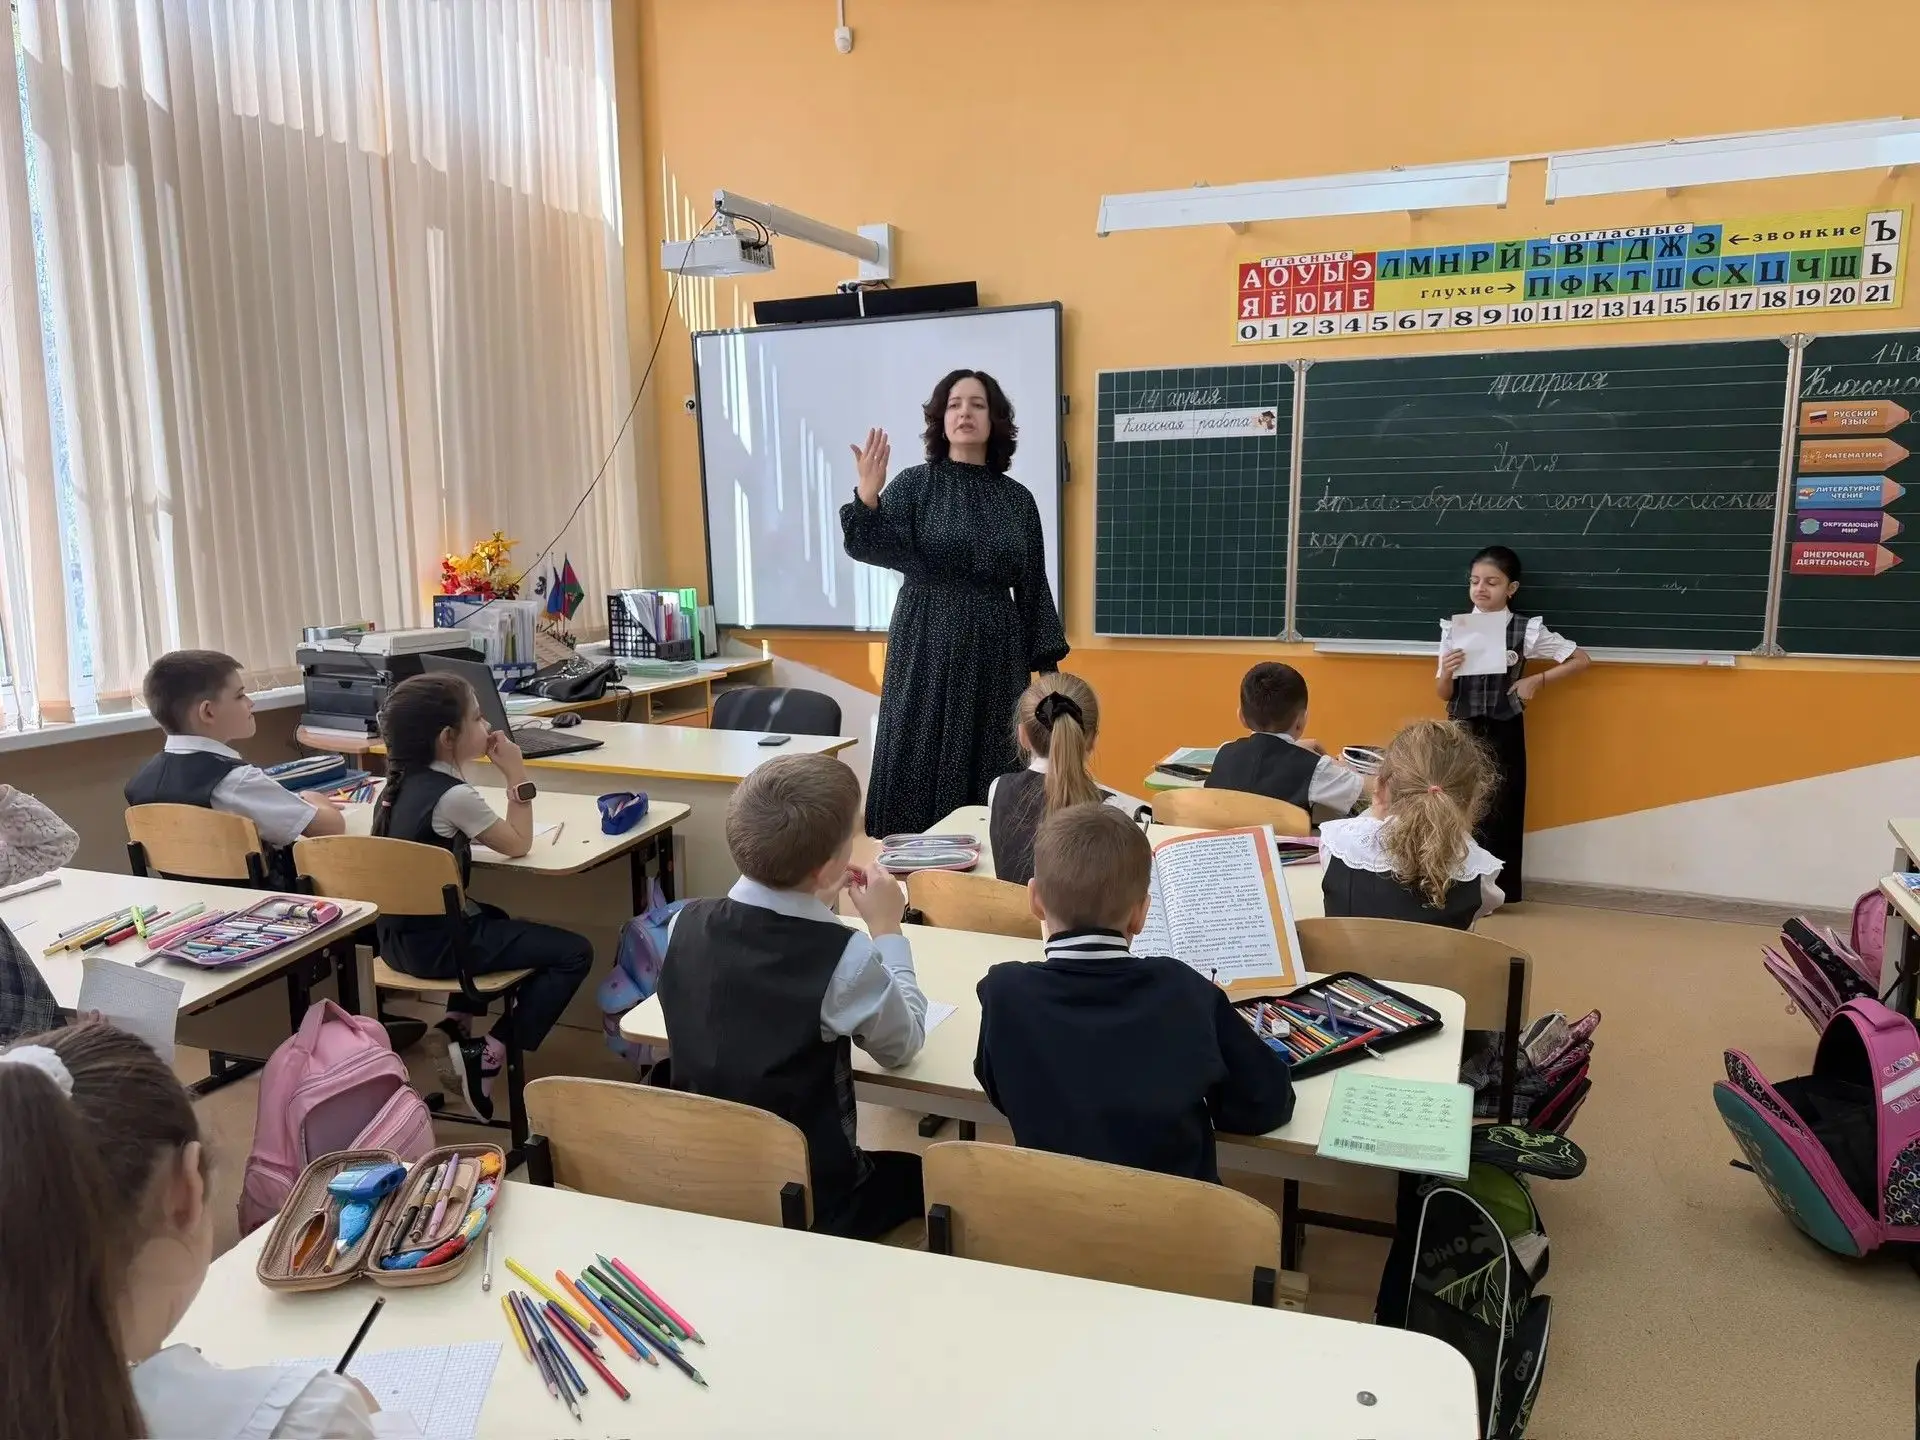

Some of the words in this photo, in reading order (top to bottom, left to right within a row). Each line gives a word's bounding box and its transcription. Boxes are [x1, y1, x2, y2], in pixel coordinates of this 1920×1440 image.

[1557, 224, 1685, 243] согласные
[1752, 226, 1861, 242] звонкие
[1871, 220, 1897, 242] Ъ
[1264, 251, 1348, 266] гласные
[1870, 253, 1892, 275] Ь
[1420, 284, 1494, 300] глухие
[1240, 325, 1257, 339] 0
[1268, 323, 1281, 338] 1
[1292, 321, 1308, 336] 2
[1318, 320, 1334, 334] 3
[1344, 318, 1361, 332] 4
[1371, 316, 1388, 331] 5
[1399, 314, 1416, 329] 6
[1428, 313, 1443, 328] 7
[1454, 311, 1473, 326] 8
[1483, 309, 1501, 324] 9
[1512, 307, 1533, 323] 10
[1541, 305, 1561, 321] 11
[1571, 303, 1593, 319] 12
[1602, 302, 1624, 317] 13
[1633, 300, 1655, 315] 14
[1664, 298, 1687, 314] 15
[1696, 295, 1721, 312] 16
[1729, 293, 1753, 310] 17
[1761, 291, 1786, 308] 18
[1795, 289, 1820, 306] 19
[1829, 287, 1855, 304] 20
[1865, 285, 1890, 303] 21
[1870, 342, 1902, 364] 14
[1833, 408, 1878, 418] РУССКИЙ
[1123, 417, 1184, 433] Классная
[1196, 411, 1250, 434] работа
[1841, 418, 1869, 426] ЯЗЫК
[1816, 485, 1881, 493] ЛИТЕРАТУРНОЕ
[1823, 521, 1879, 529] ОКРУЖАЮЩИЙ
[1803, 550, 1865, 558] ВНЕУРОЧНАЯ
[1796, 559, 1870, 567] ДЕЯТЕЛЬНОСТЬ
[1883, 1052, 1919, 1077] CANDY
